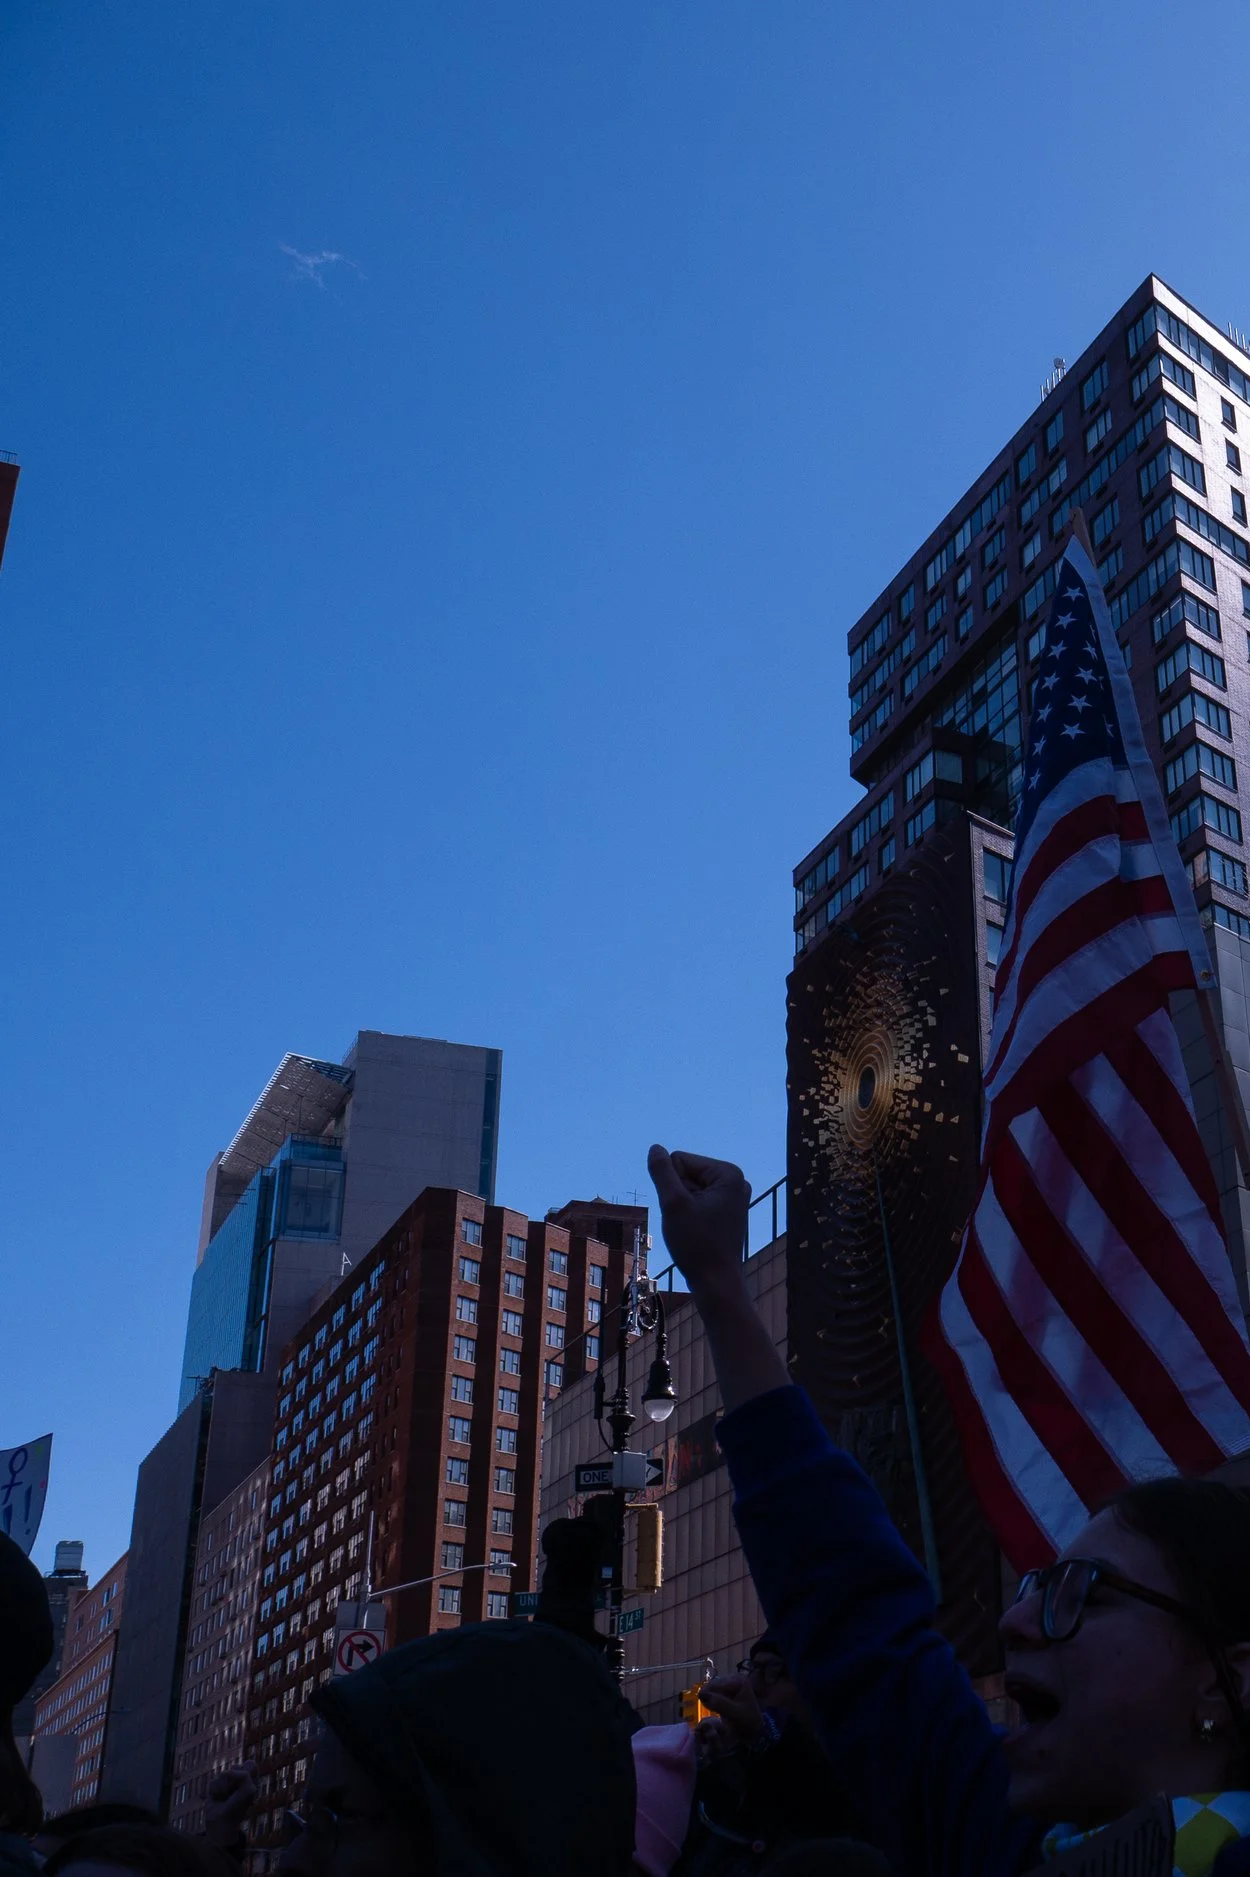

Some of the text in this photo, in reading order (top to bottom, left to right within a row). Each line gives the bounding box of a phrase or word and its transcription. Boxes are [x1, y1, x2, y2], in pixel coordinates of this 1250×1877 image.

[583, 1470, 609, 1484] ONE
[620, 1610, 643, 1633] E 14 ST
